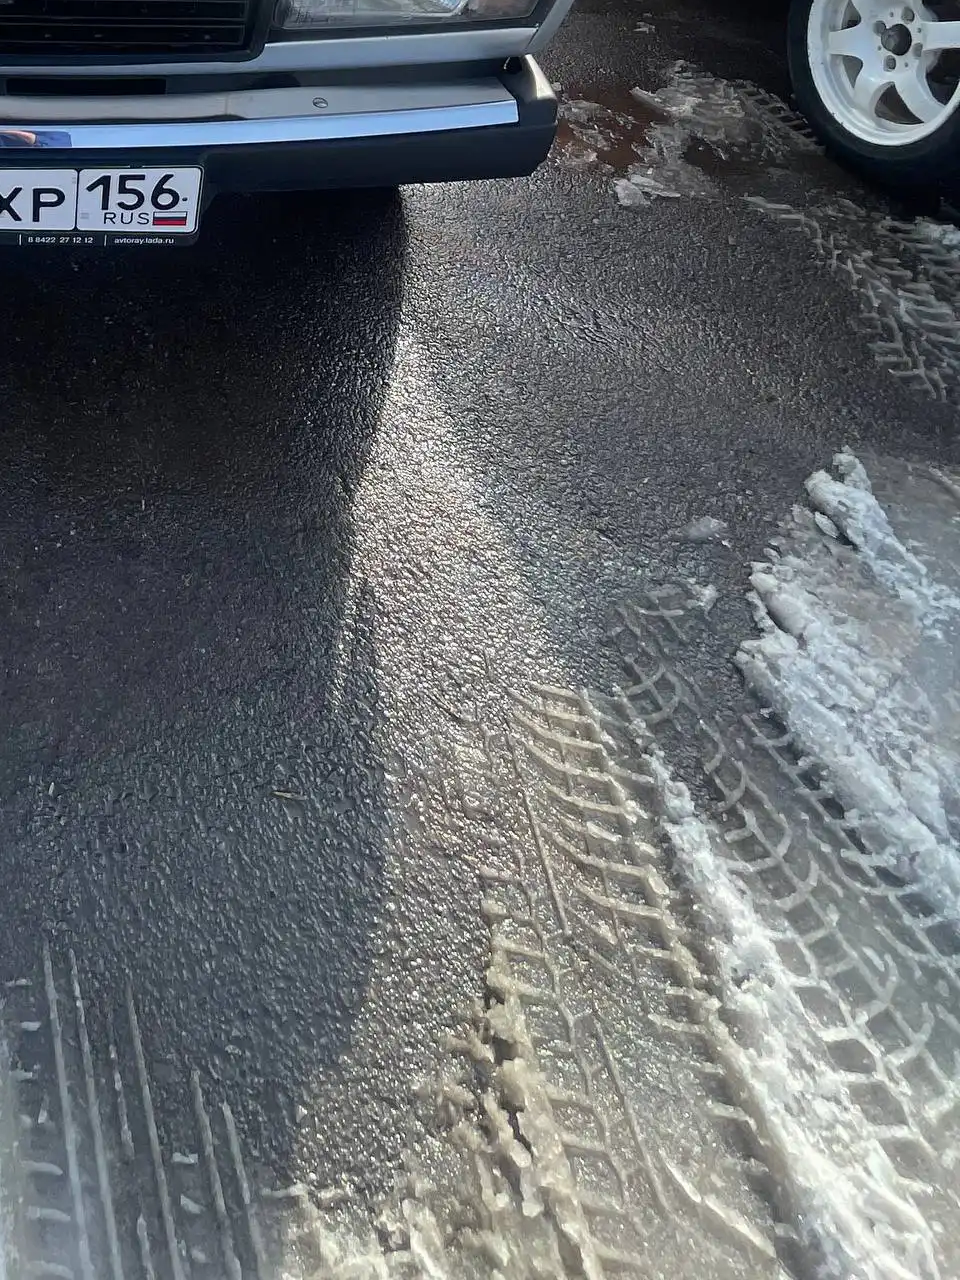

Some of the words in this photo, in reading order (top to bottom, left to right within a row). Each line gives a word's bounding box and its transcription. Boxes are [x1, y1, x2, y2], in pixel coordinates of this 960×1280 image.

[85, 174, 180, 211] 156
[103, 211, 150, 226] RUS
[72, 236, 82, 244] 12
[84, 236, 94, 244] 12
[114, 237, 175, 245] avtoray.lada.ru
